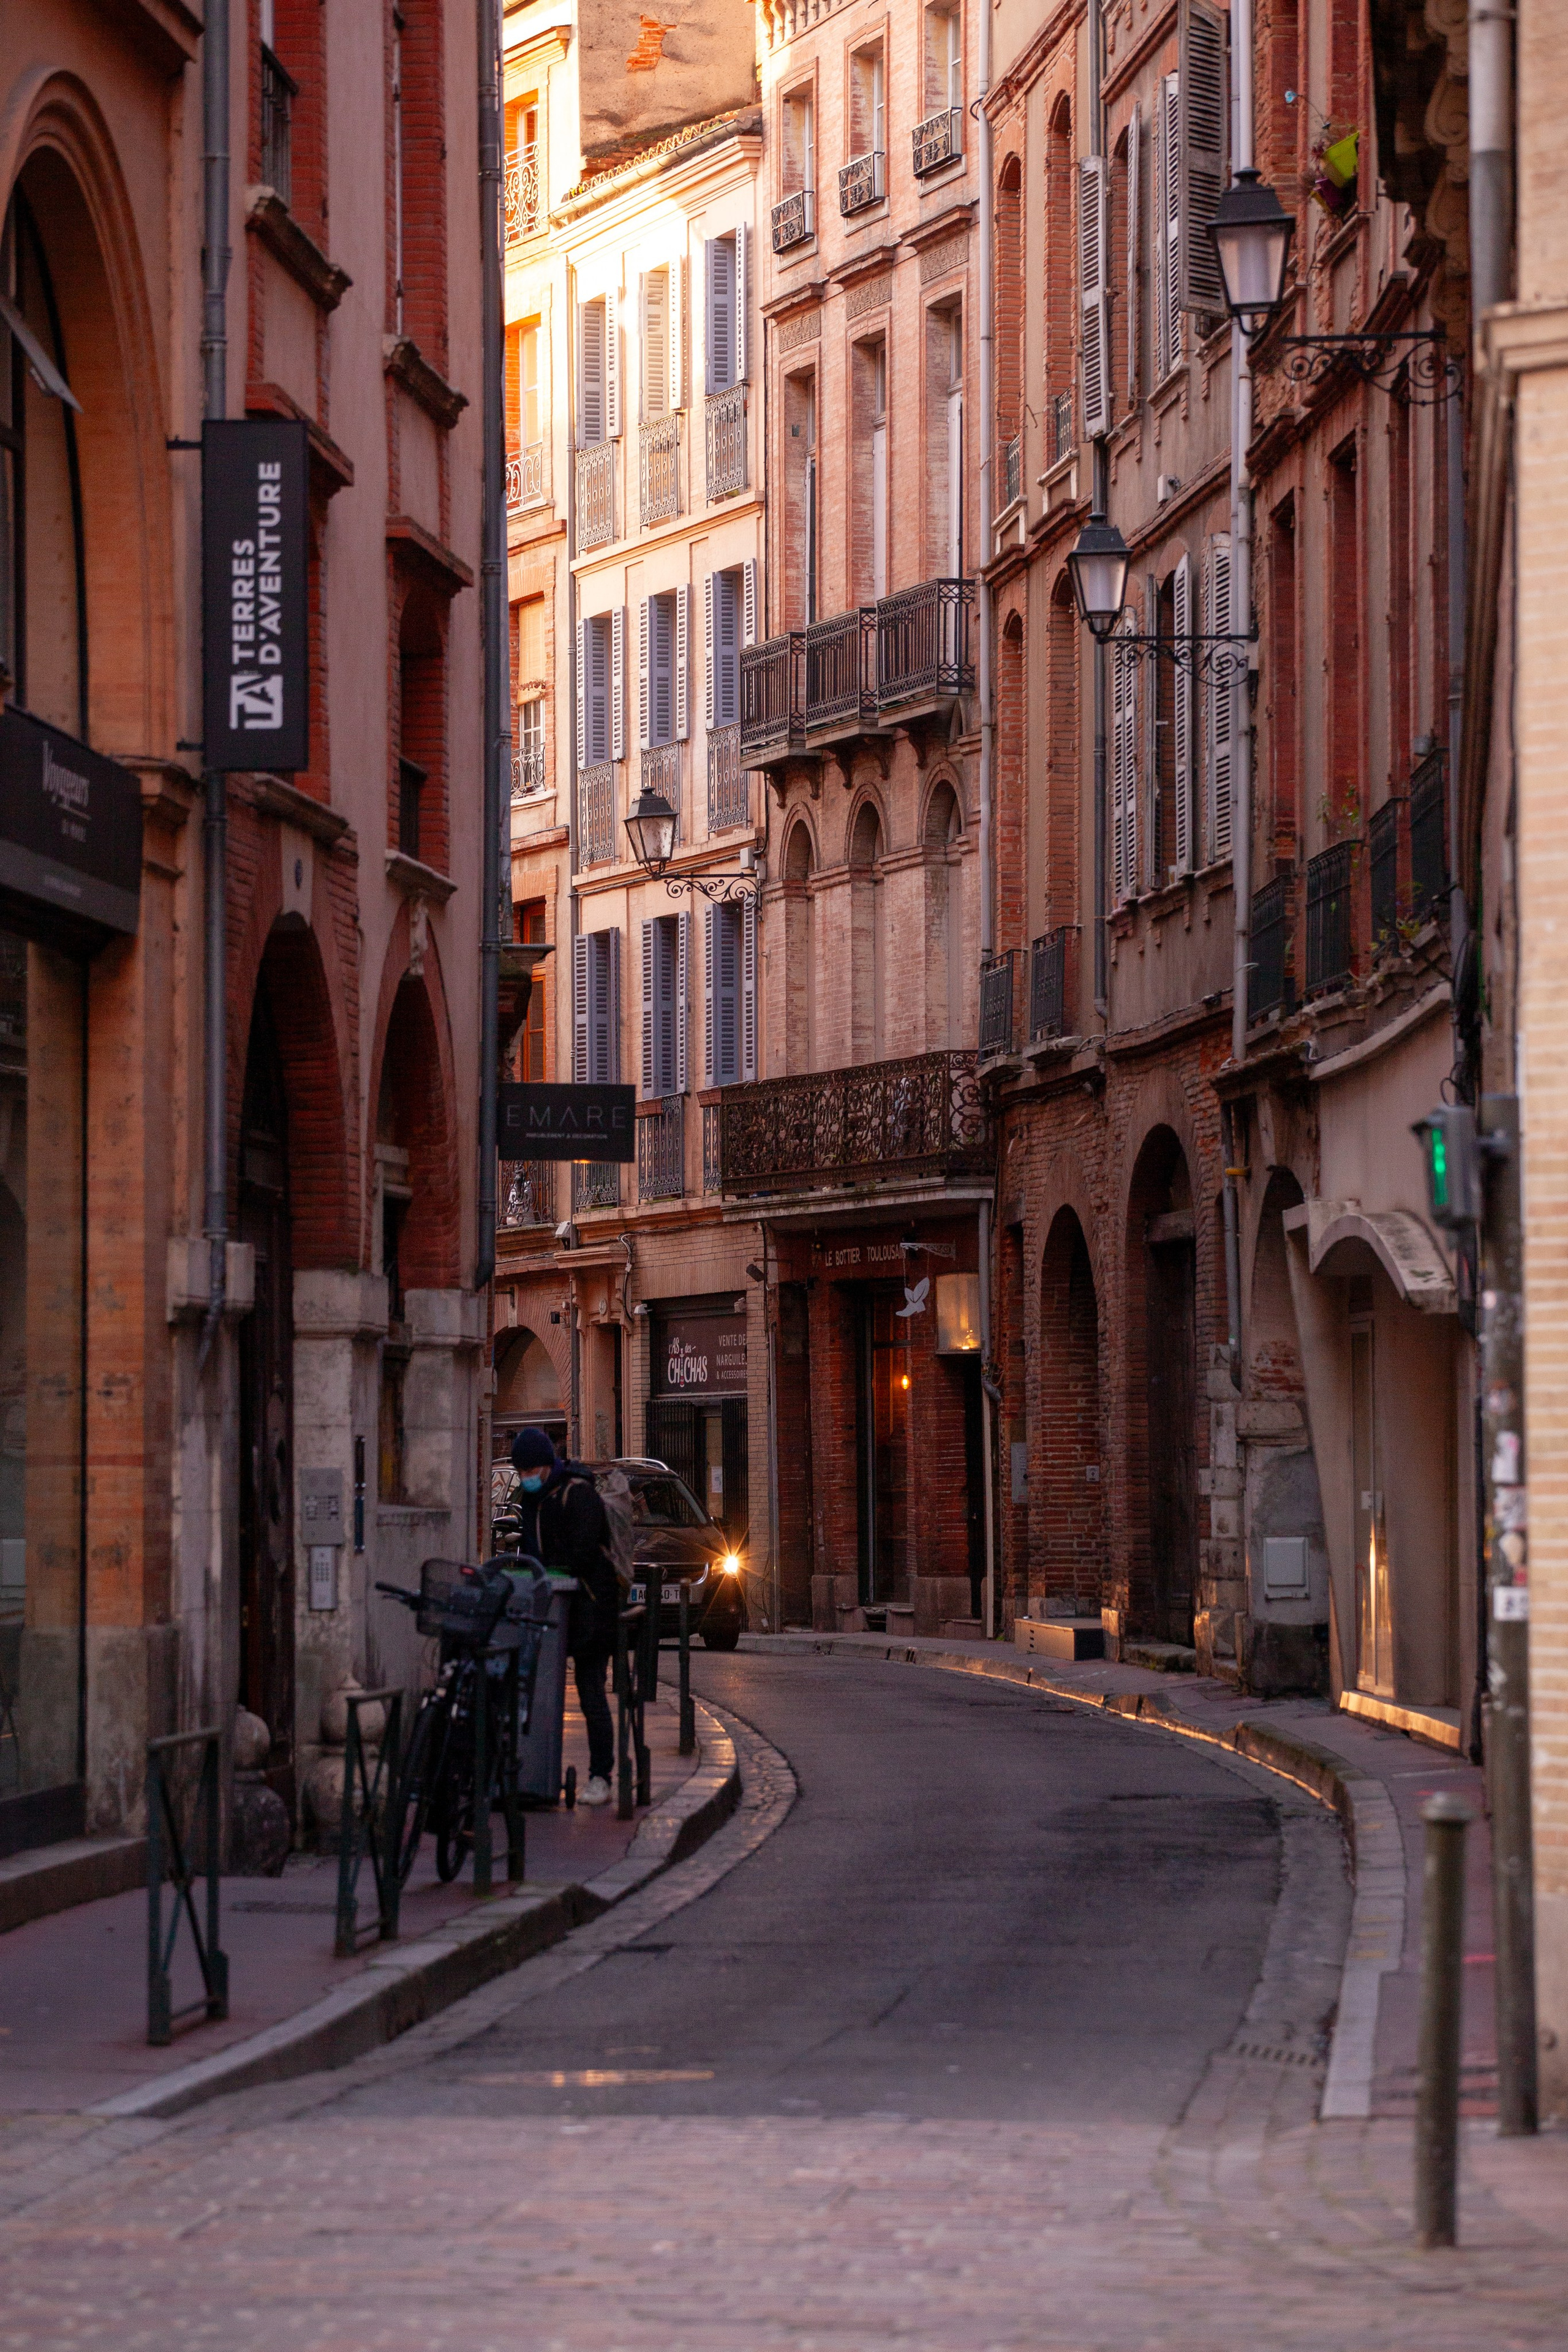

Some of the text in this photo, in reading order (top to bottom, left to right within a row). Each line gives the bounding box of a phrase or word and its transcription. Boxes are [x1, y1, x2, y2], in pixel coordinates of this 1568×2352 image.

[258, 462, 281, 665] D'AVENTURE
[232, 538, 255, 665] TERRES
[826, 1244, 906, 1267] LE BOTTIER TOULOUSAIN
[718, 1333, 746, 1346] VENTE DE
[716, 1371, 720, 1379] &
